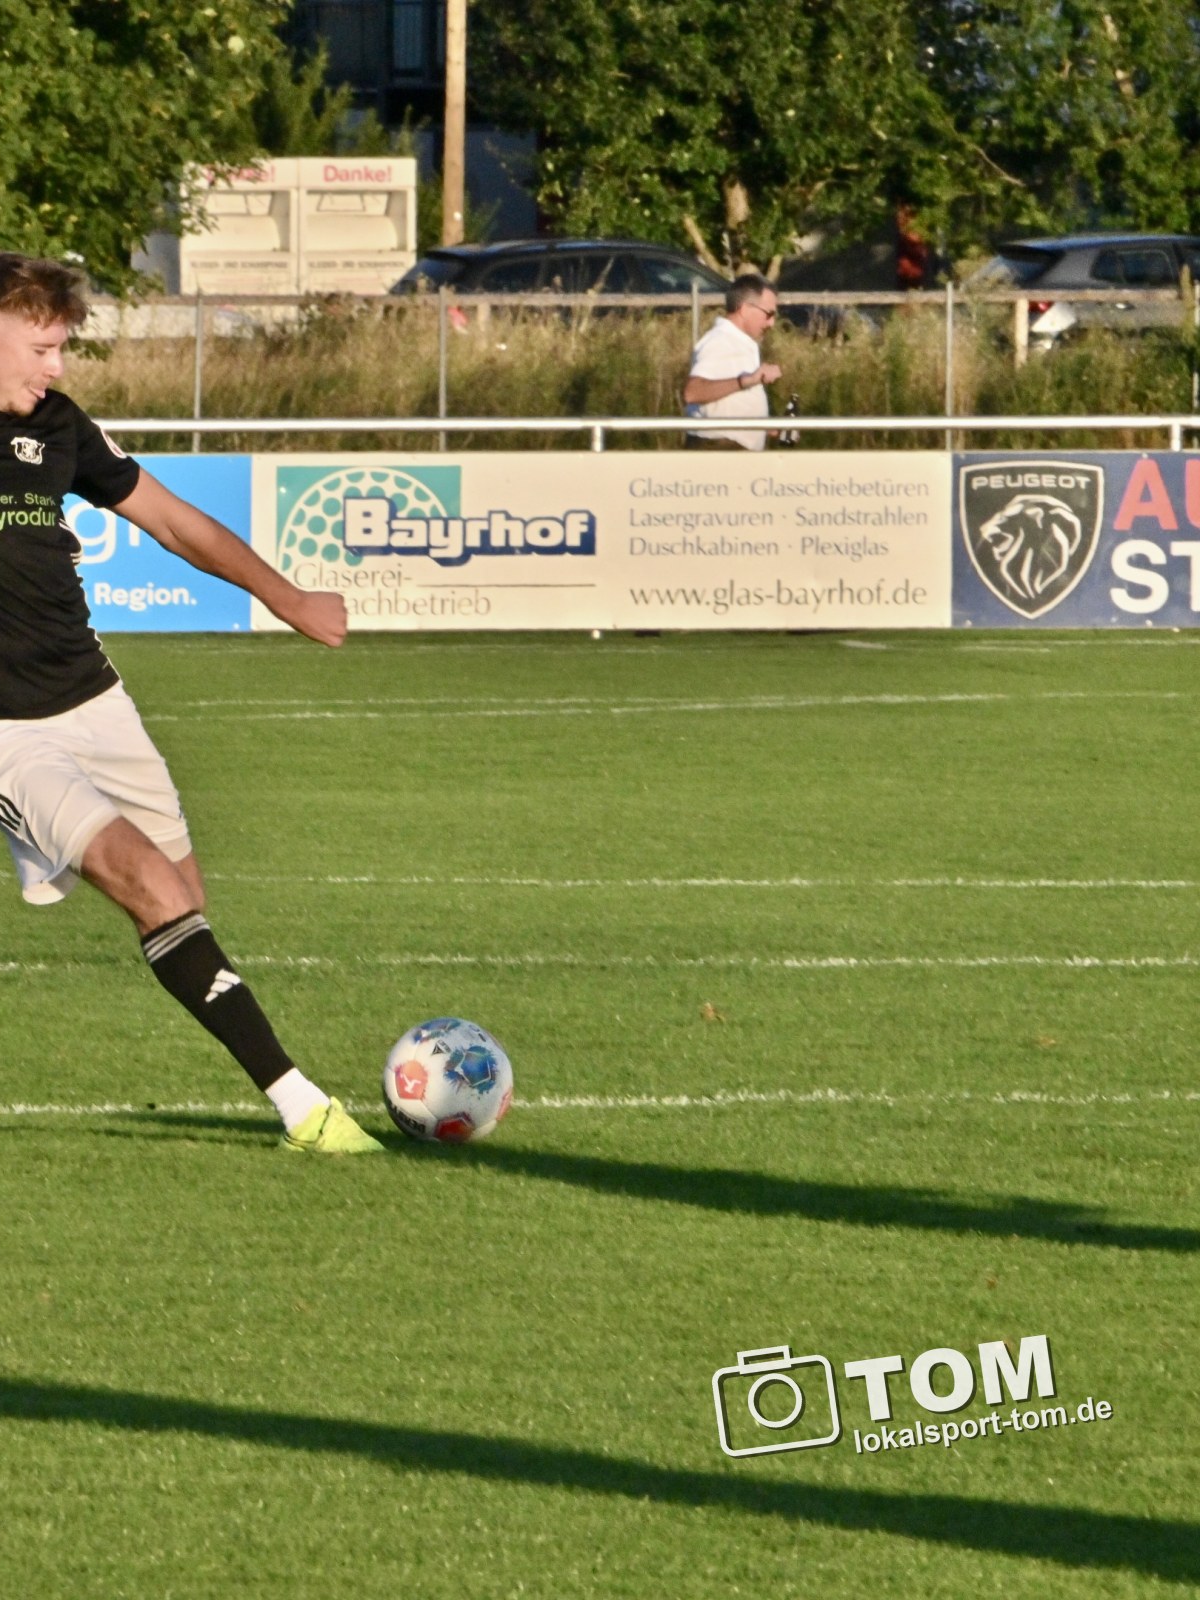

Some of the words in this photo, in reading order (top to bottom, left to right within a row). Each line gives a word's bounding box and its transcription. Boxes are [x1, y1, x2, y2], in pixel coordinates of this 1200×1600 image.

[323, 165, 393, 183] Danke!
[629, 477, 729, 498] Glastüren
[750, 477, 930, 498] Glasschiebetüren
[971, 473, 1092, 490] PEUGEOT
[1112, 458, 1200, 531] A
[343, 496, 596, 567] Bayrhof
[629, 507, 774, 533] Lasergravuren
[794, 506, 929, 527] Sandstrahlen
[629, 536, 780, 557] Duschkabinen
[801, 535, 890, 563] Plexiglas
[293, 562, 413, 589] Glaserei-
[94, 582, 198, 612] Region.
[343, 588, 491, 617] achbetrieb
[629, 579, 928, 615] www.glas-bayrhof.de
